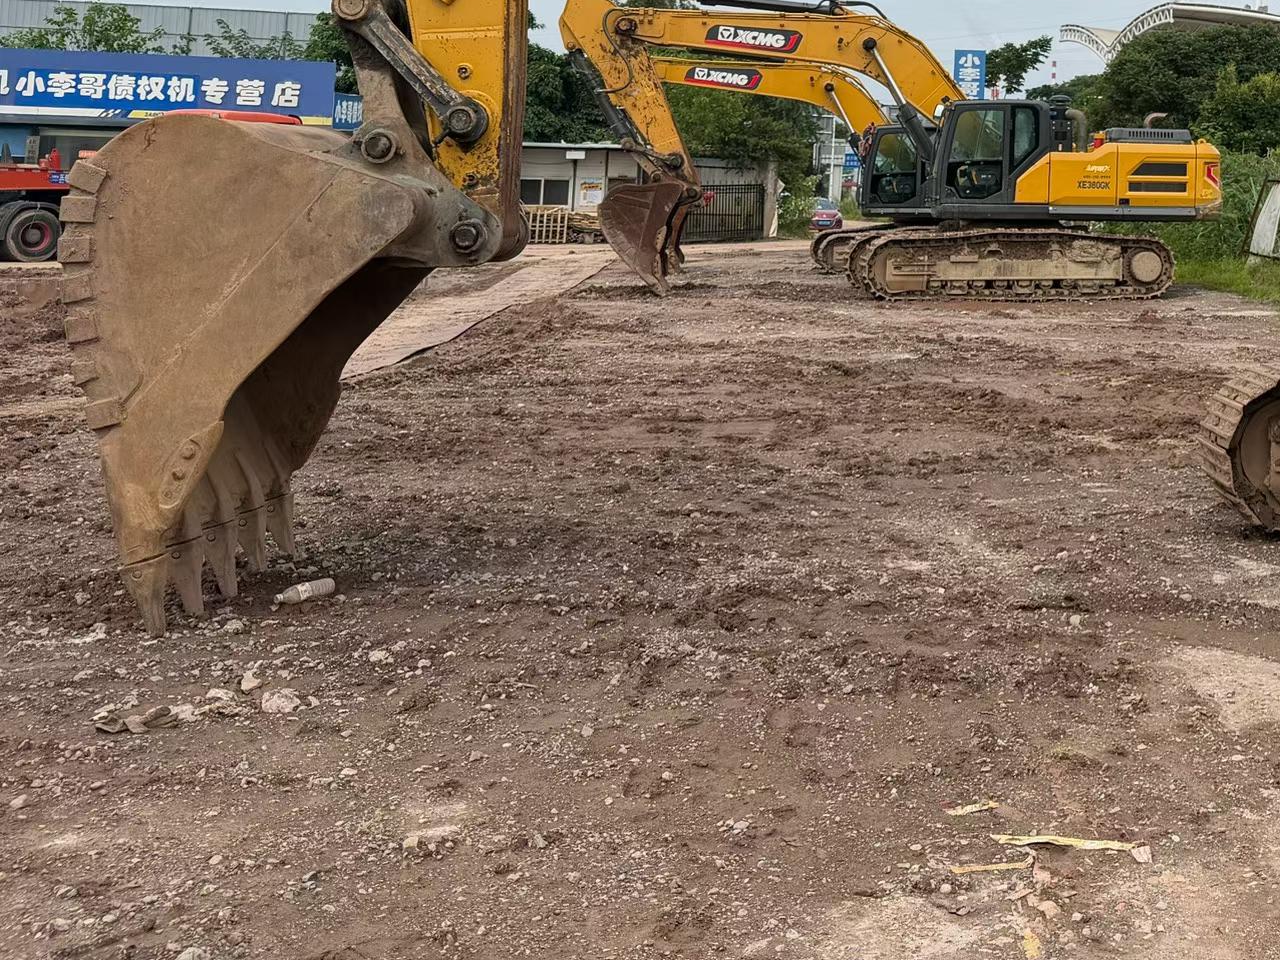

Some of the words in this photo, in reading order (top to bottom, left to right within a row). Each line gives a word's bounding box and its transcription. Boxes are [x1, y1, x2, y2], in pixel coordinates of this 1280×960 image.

[733, 29, 786, 48] XCMG
[706, 70, 749, 86] XCMG
[959, 53, 980, 99] 小李哥
